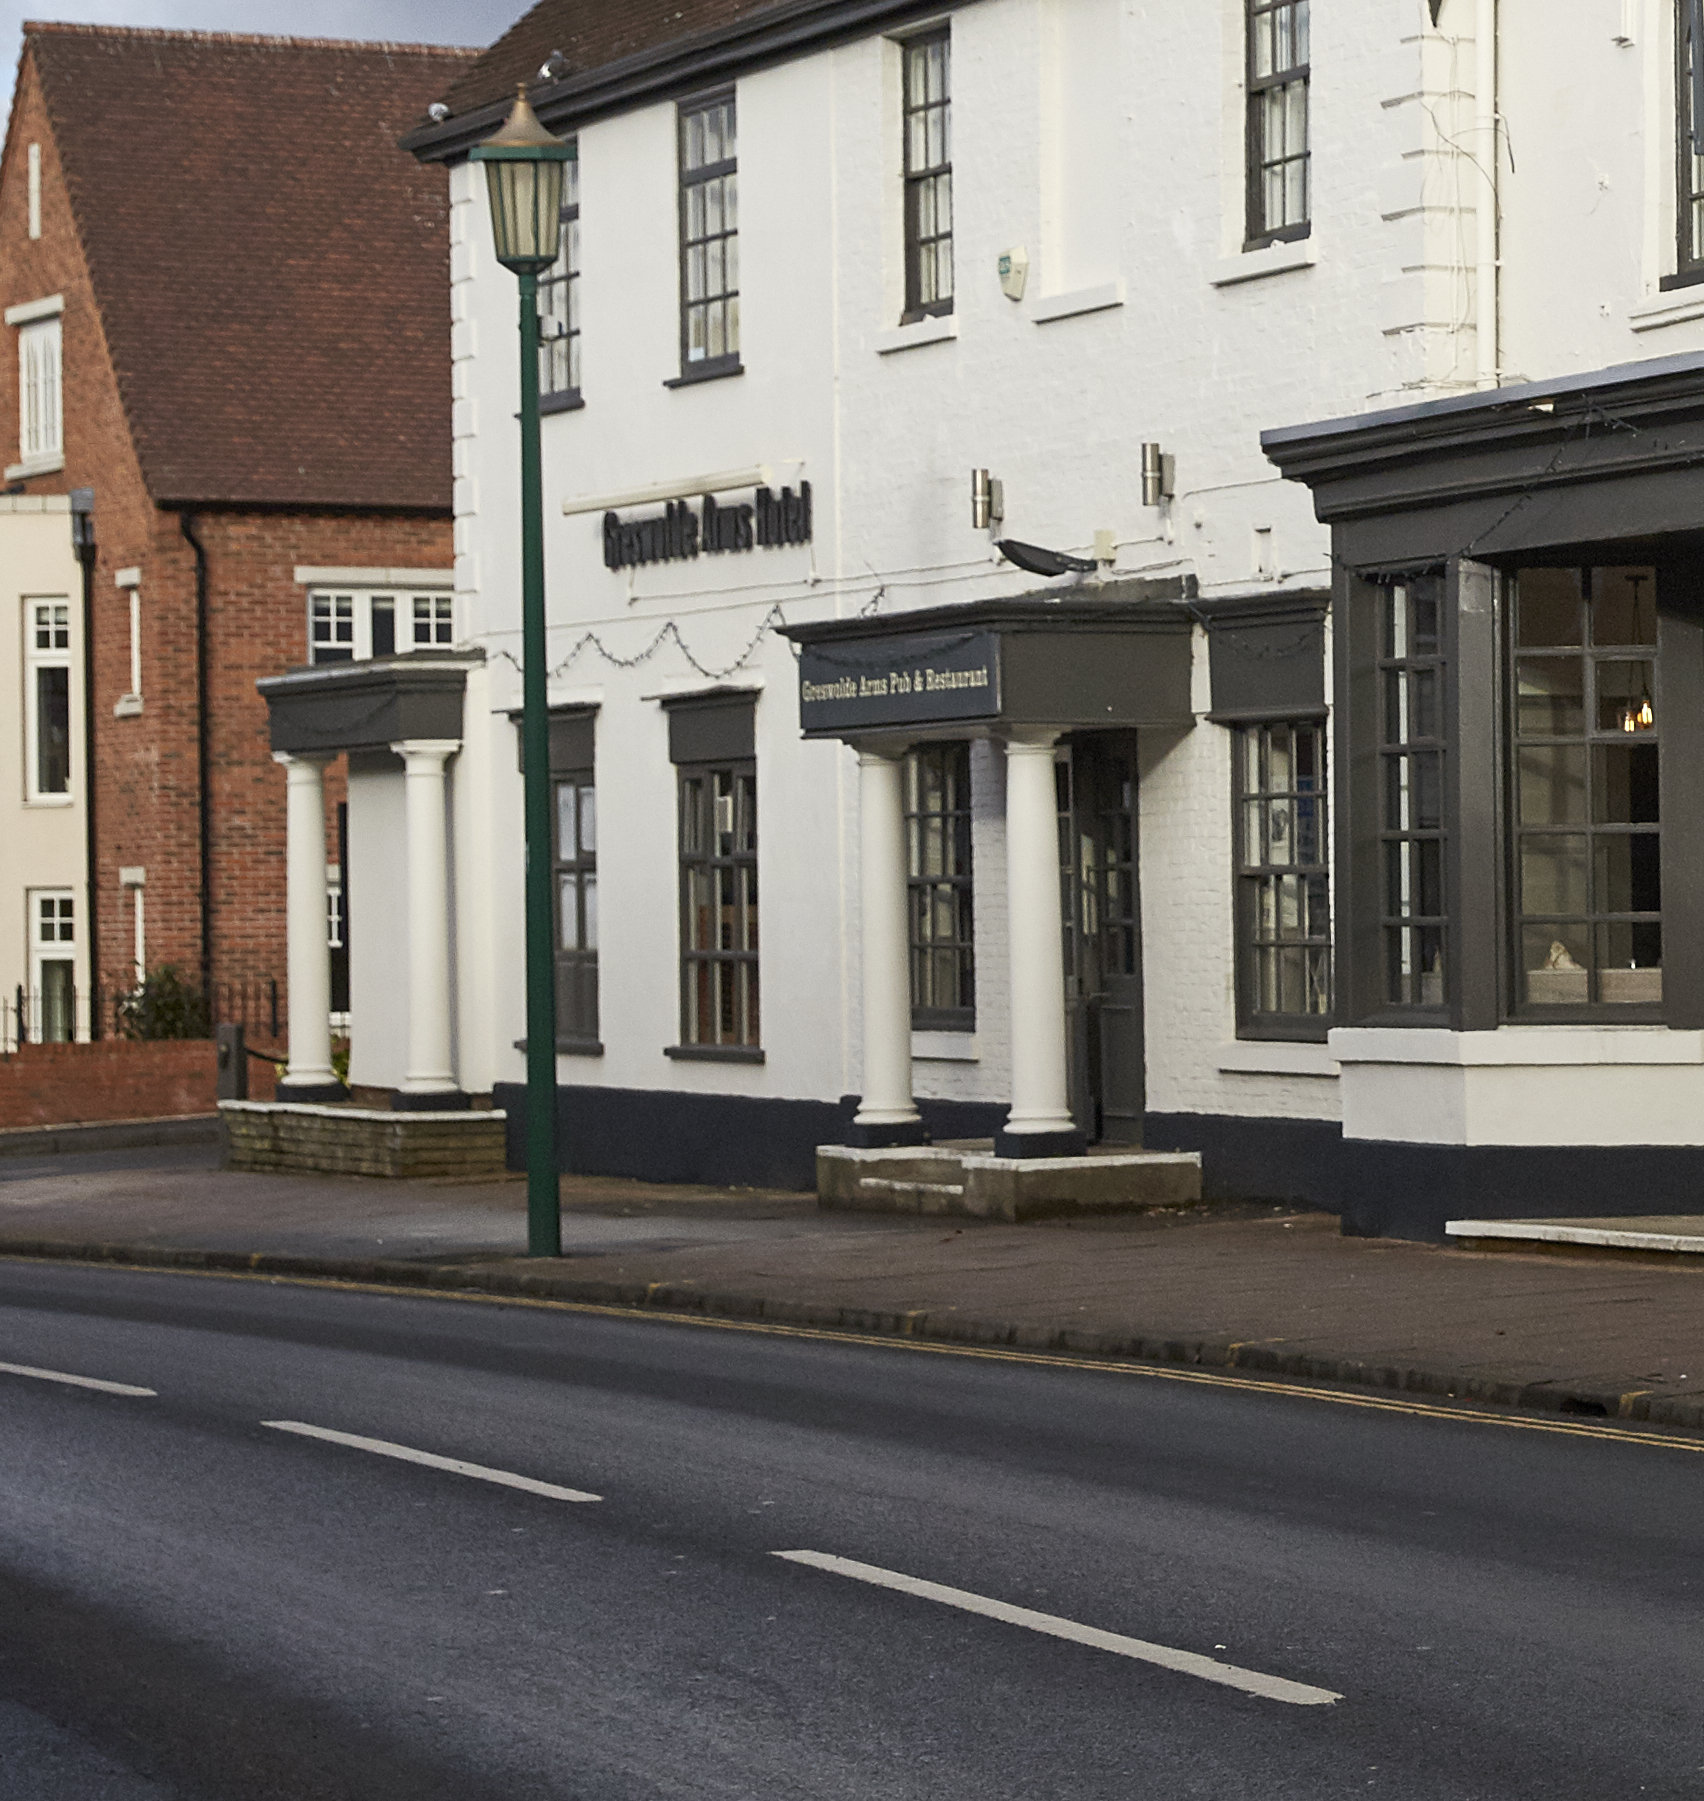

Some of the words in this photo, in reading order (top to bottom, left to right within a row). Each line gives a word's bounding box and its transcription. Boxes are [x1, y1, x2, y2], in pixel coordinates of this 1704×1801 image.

[802, 676, 858, 703] Greswolde
[858, 675, 888, 698] Arms
[889, 671, 912, 695] Pub
[913, 669, 924, 692] &
[925, 665, 988, 691] Restaurant
